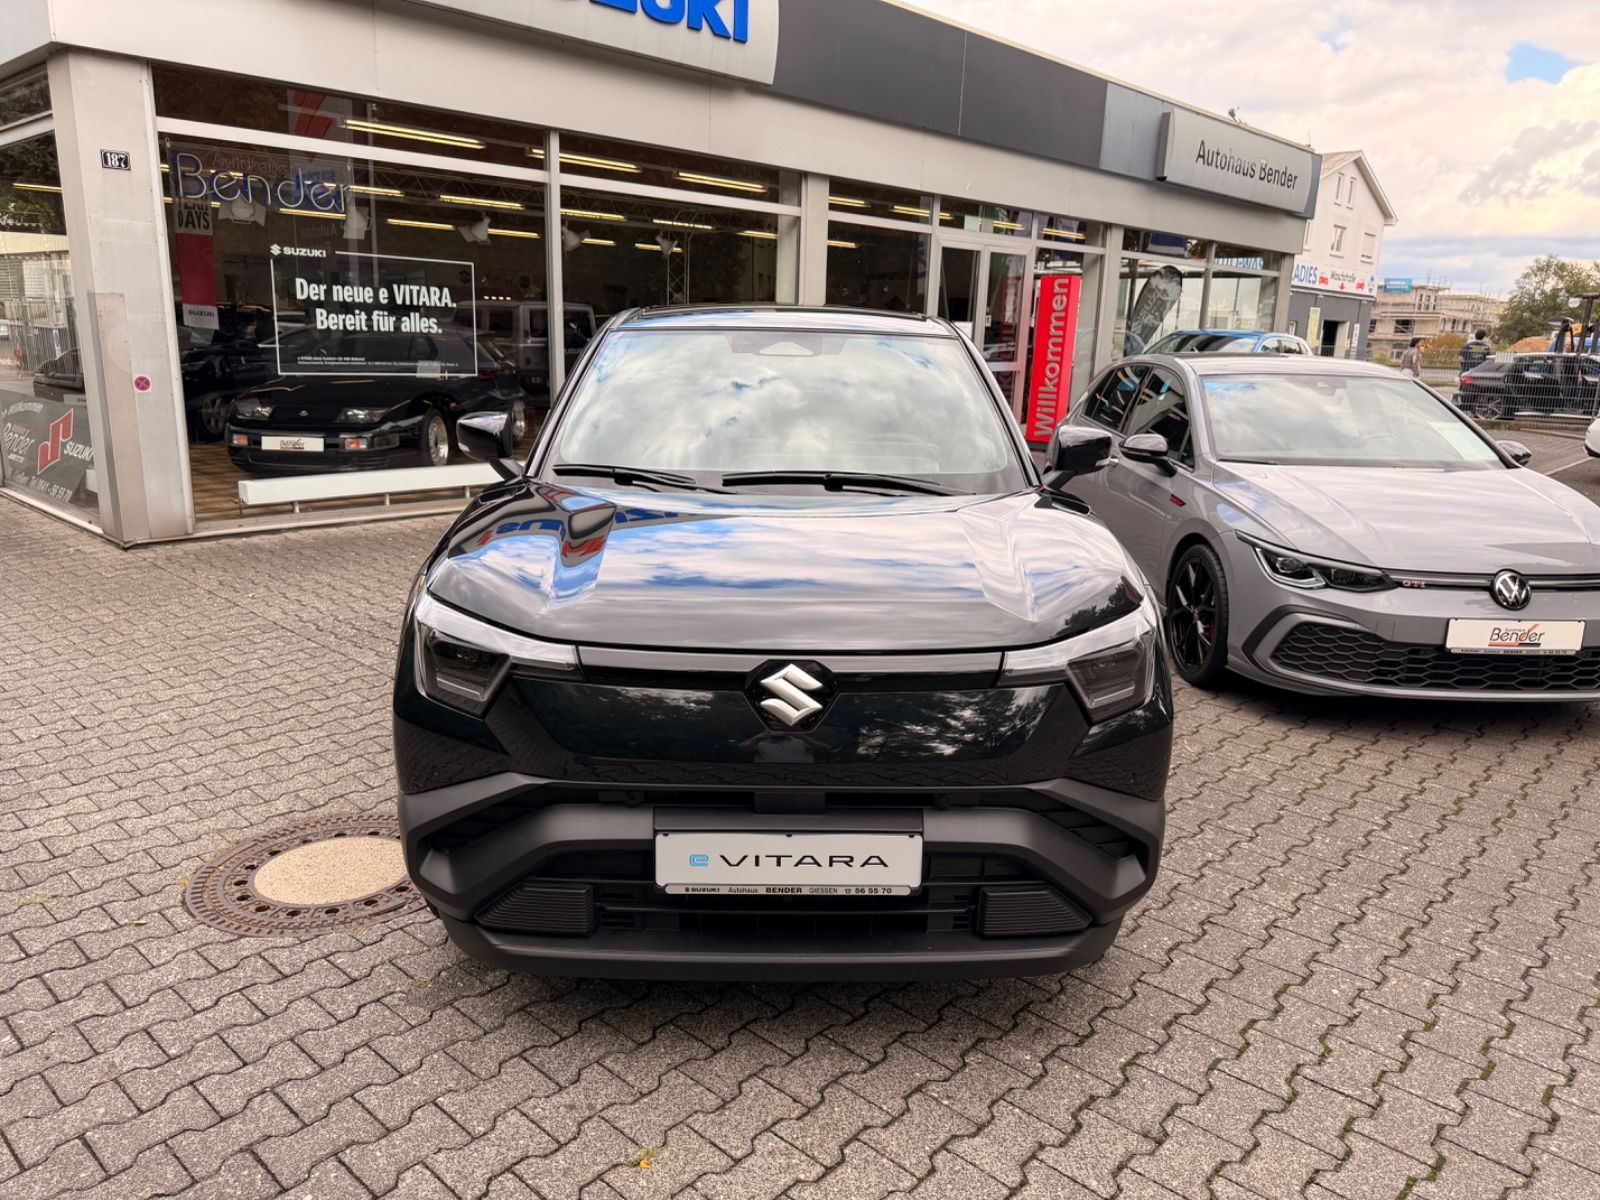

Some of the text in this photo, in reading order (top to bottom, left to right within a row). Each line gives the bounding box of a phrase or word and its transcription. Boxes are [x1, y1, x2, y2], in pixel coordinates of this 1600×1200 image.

[104, 151, 127, 168] 187
[1195, 139, 1298, 190] Autohaus Bender
[175, 152, 350, 213] Bender
[283, 246, 327, 258] SUZUKI
[1293, 264, 1318, 285] ADIES
[295, 277, 457, 308] Der neue e VITARA.
[316, 308, 443, 334] Bereit für alles.
[1034, 278, 1069, 437] Willkommen
[63, 441, 94, 462] SUZUKI
[1402, 579, 1426, 588] GTI
[1490, 624, 1545, 642] Bender
[719, 854, 889, 868] VITARA
